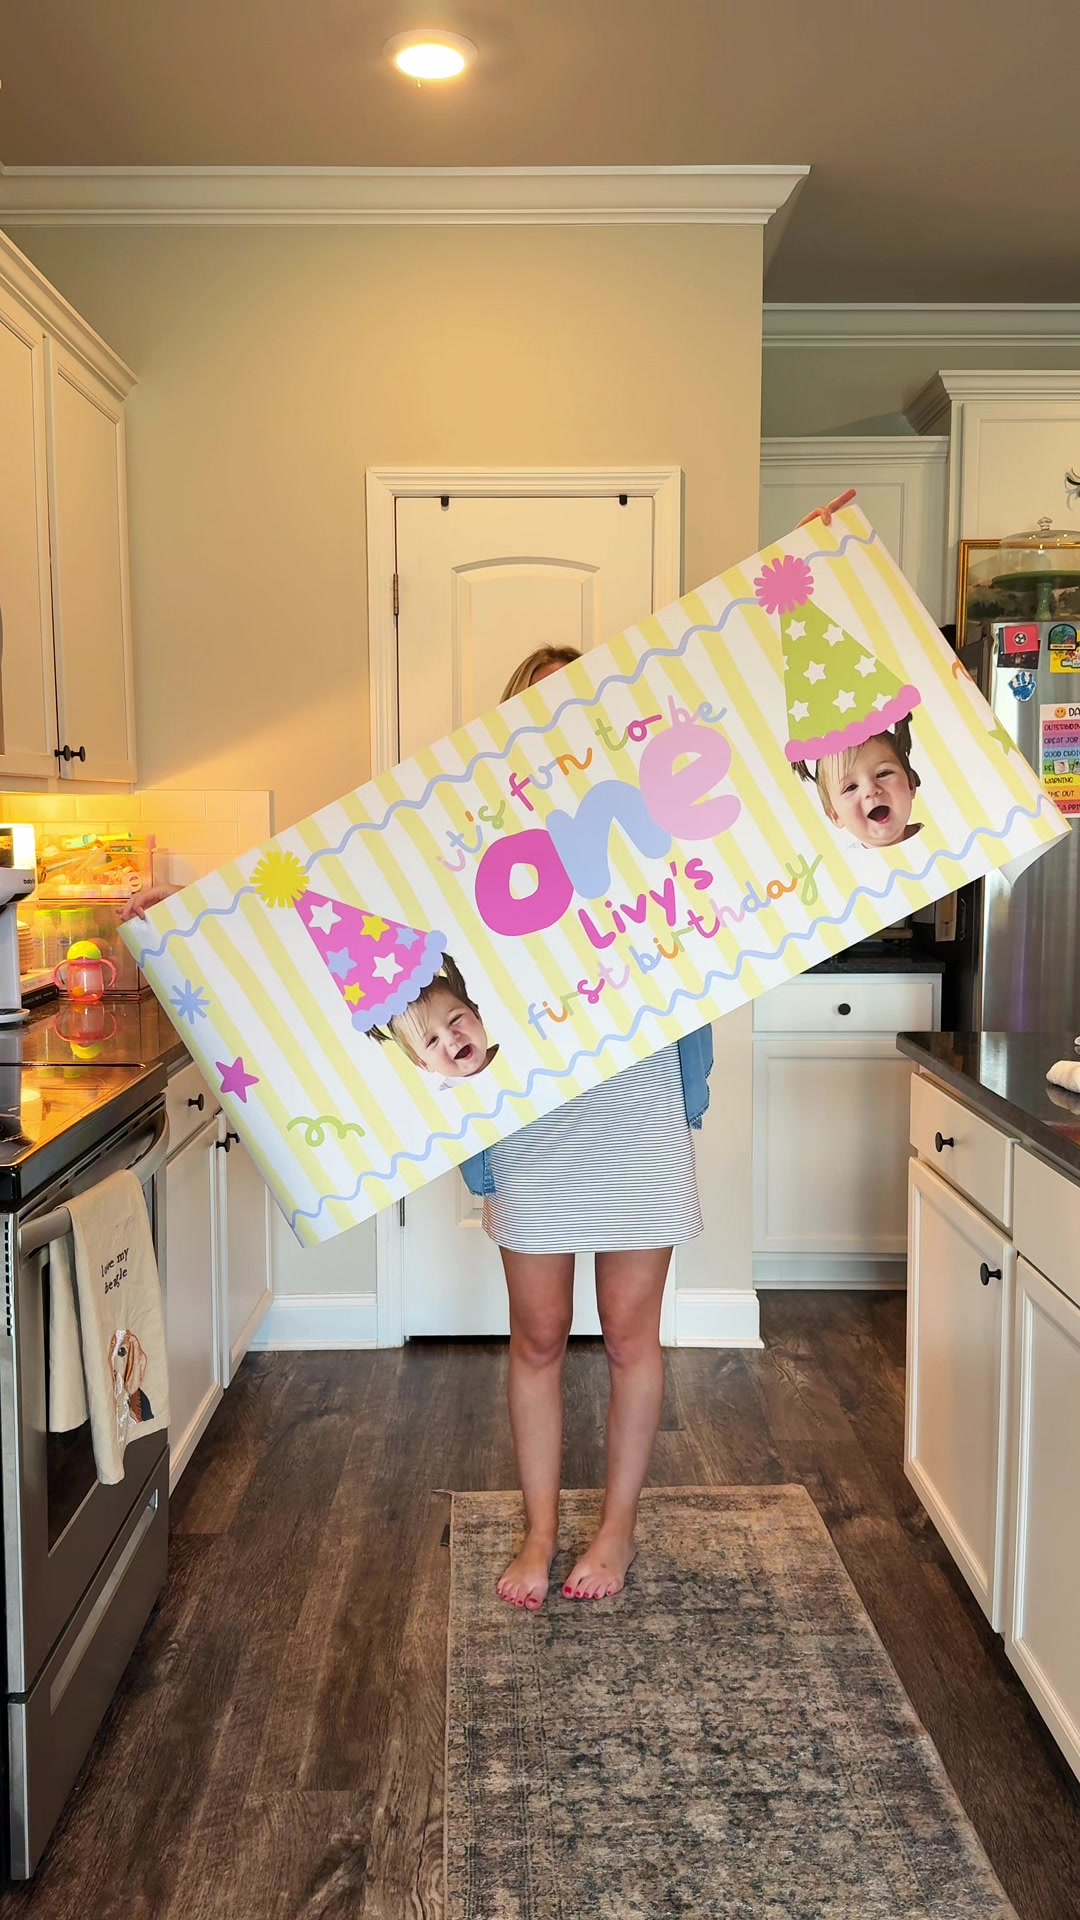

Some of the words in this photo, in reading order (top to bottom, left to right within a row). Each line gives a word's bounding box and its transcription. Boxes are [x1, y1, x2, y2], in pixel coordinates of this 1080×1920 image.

[436, 800, 505, 872] it's
[509, 747, 593, 811] fun
[595, 715, 662, 751] to
[667, 695, 728, 726] be
[1044, 750, 1061, 758] GOOD
[1063, 749, 1080, 757] CHOI
[1065, 736, 1078, 744] JOB
[475, 724, 741, 937] one
[527, 962, 631, 1040] first
[629, 854, 824, 975] birthday
[117, 1247, 129, 1263] my
